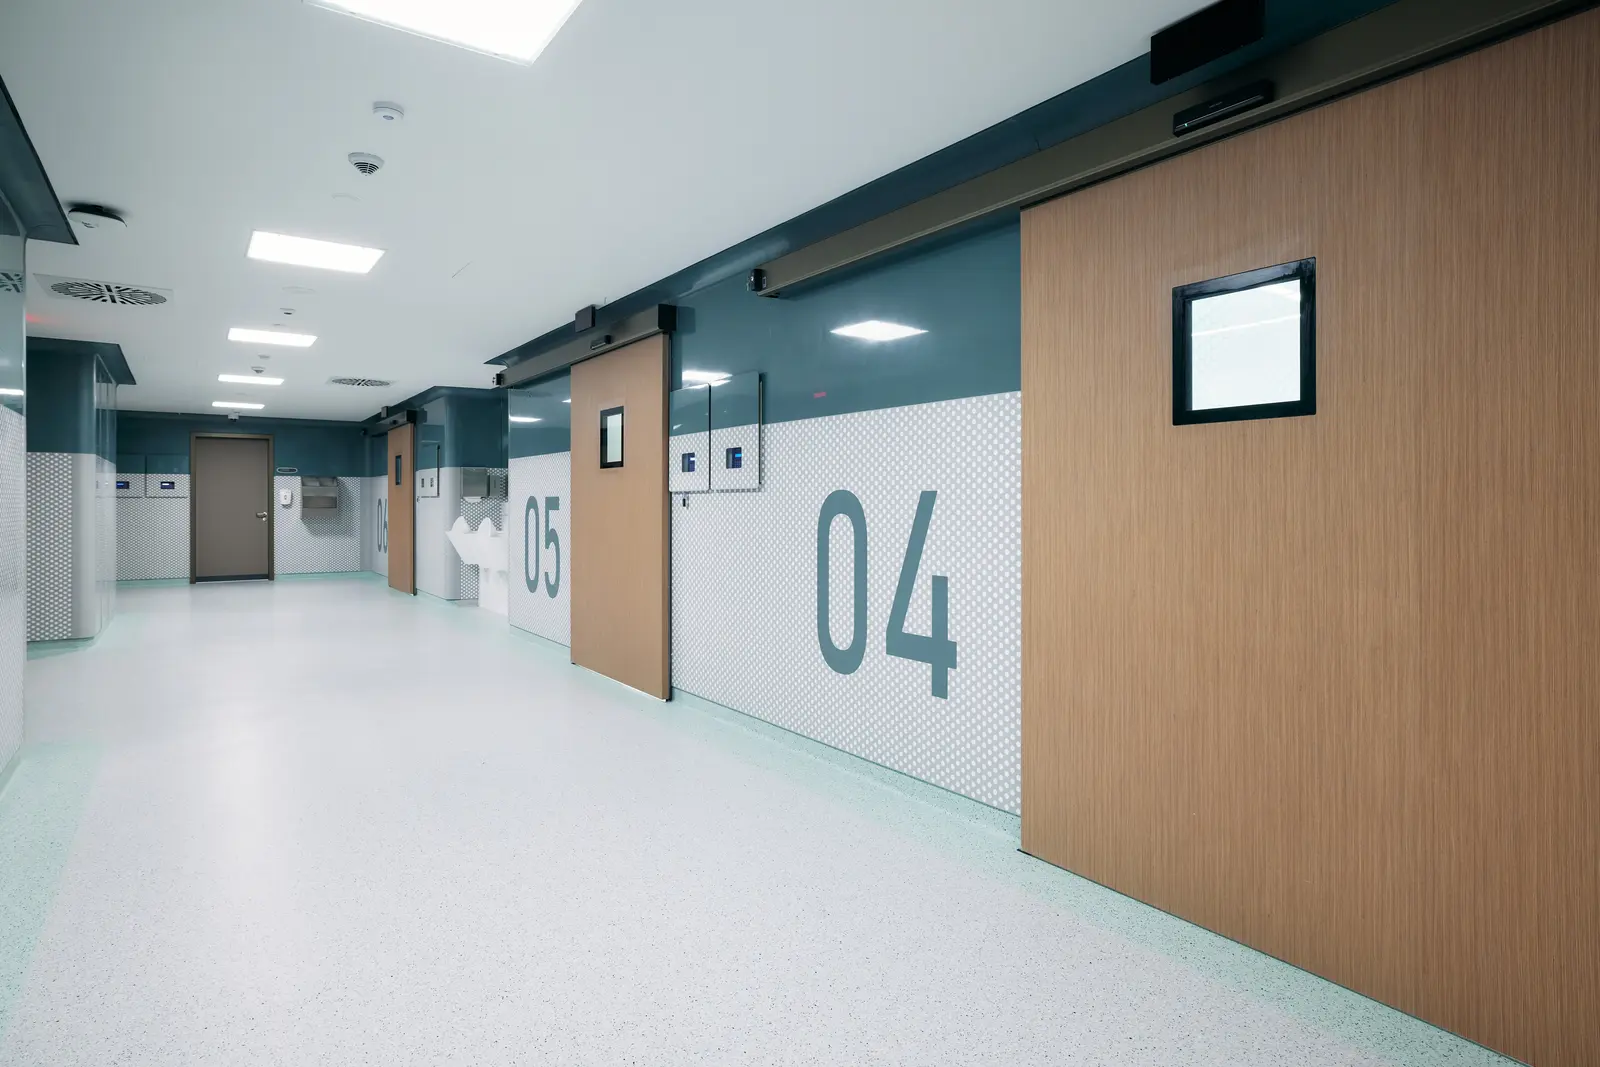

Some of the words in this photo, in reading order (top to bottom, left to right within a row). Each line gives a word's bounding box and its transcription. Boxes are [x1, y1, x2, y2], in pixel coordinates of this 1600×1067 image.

[377, 498, 388, 554] 06
[525, 495, 560, 599] 05
[817, 489, 957, 700] 04
